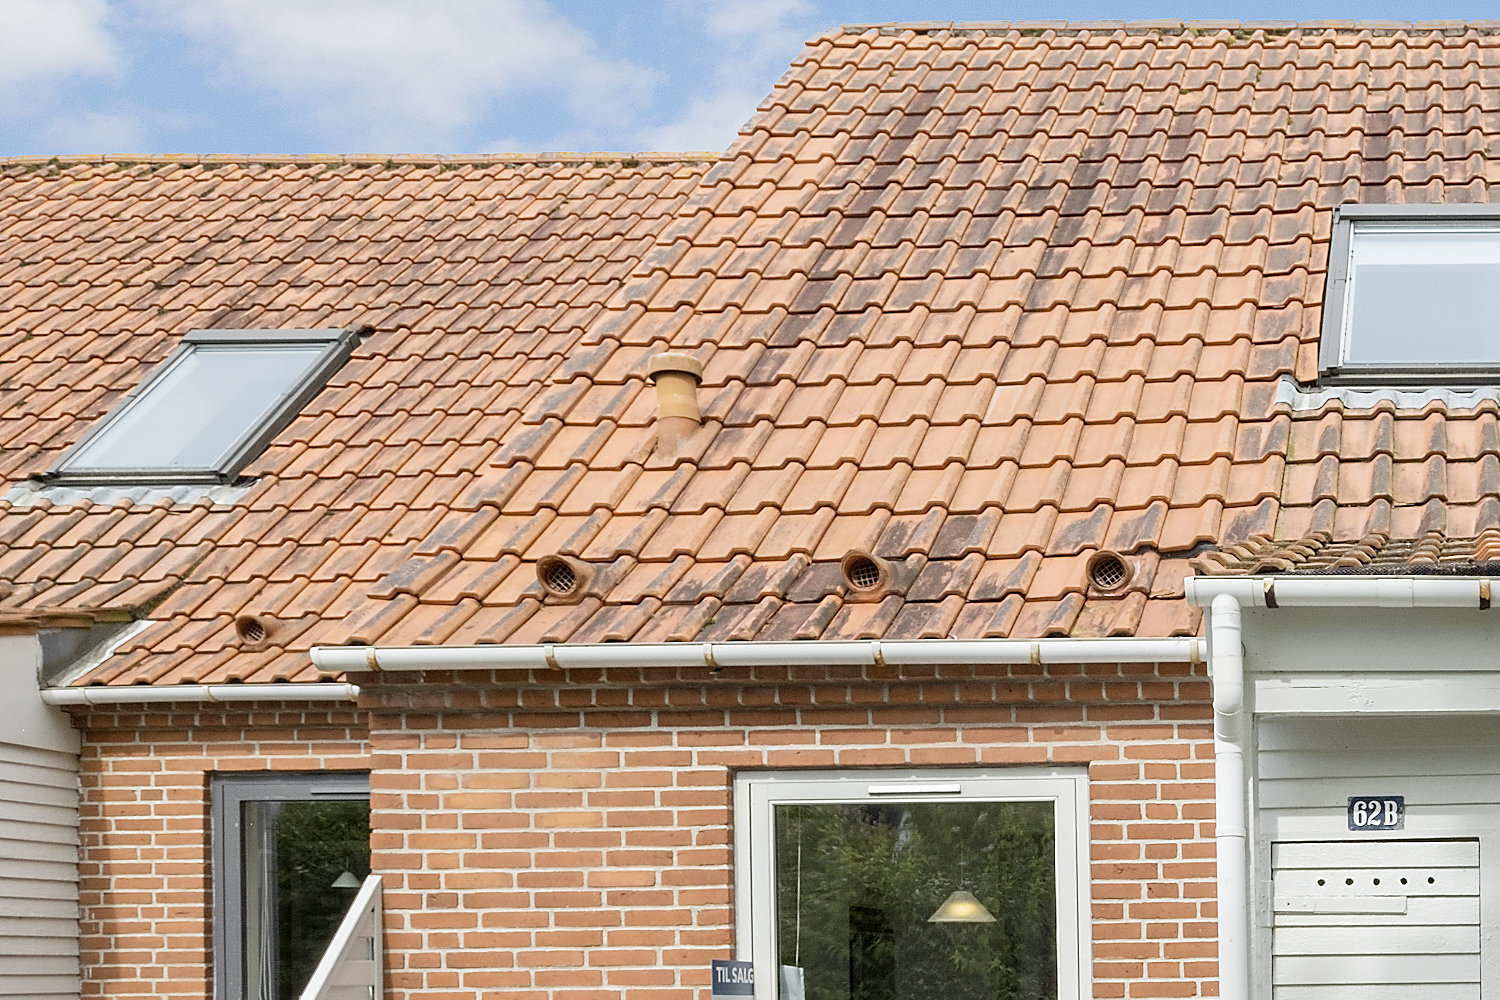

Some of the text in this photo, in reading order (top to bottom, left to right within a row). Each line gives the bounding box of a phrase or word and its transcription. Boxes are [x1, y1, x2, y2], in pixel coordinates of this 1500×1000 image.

[1353, 800, 1398, 827] 62B
[716, 966, 754, 984] TIL SALG
